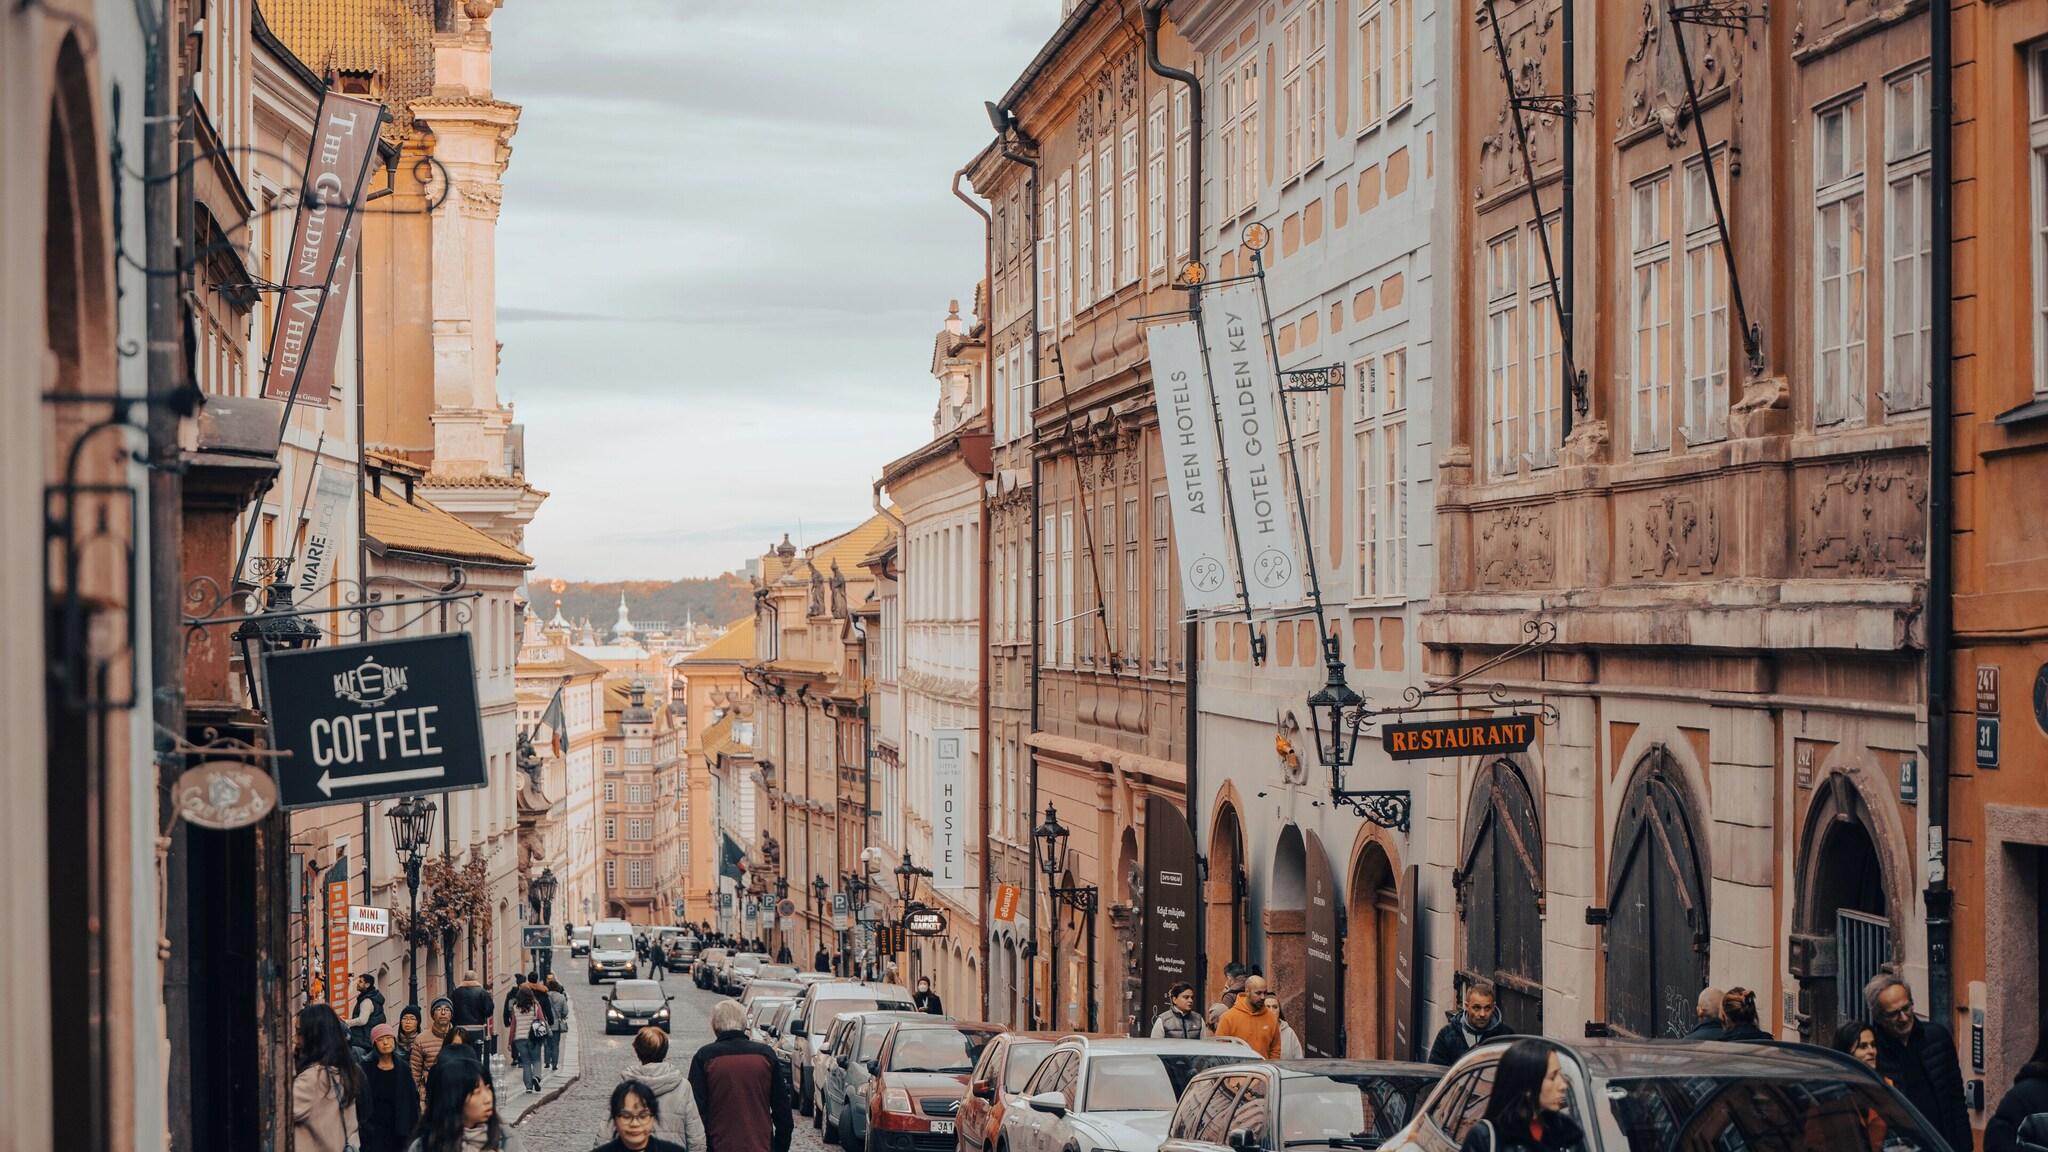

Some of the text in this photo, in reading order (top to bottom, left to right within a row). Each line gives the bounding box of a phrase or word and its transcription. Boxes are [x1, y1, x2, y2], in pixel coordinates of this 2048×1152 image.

[1225, 312, 1275, 534] HOTEL GOLDEN KEY
[1170, 370, 1206, 514] ASTEN HOTELS
[1978, 670, 1994, 691] 241
[310, 706, 442, 766] COFFEE
[1392, 724, 1527, 752] RESTAURANT
[1980, 726, 1990, 747] 31
[1902, 764, 1911, 782] 29
[944, 783, 953, 880] HOSTEL
[766, 895, 773, 906] P
[836, 896, 844, 909] P
[1001, 887, 1014, 918] change
[360, 908, 378, 920] MINI
[913, 914, 938, 922] SUPER
[352, 921, 384, 934] MARKET
[910, 922, 941, 931] MARKET
